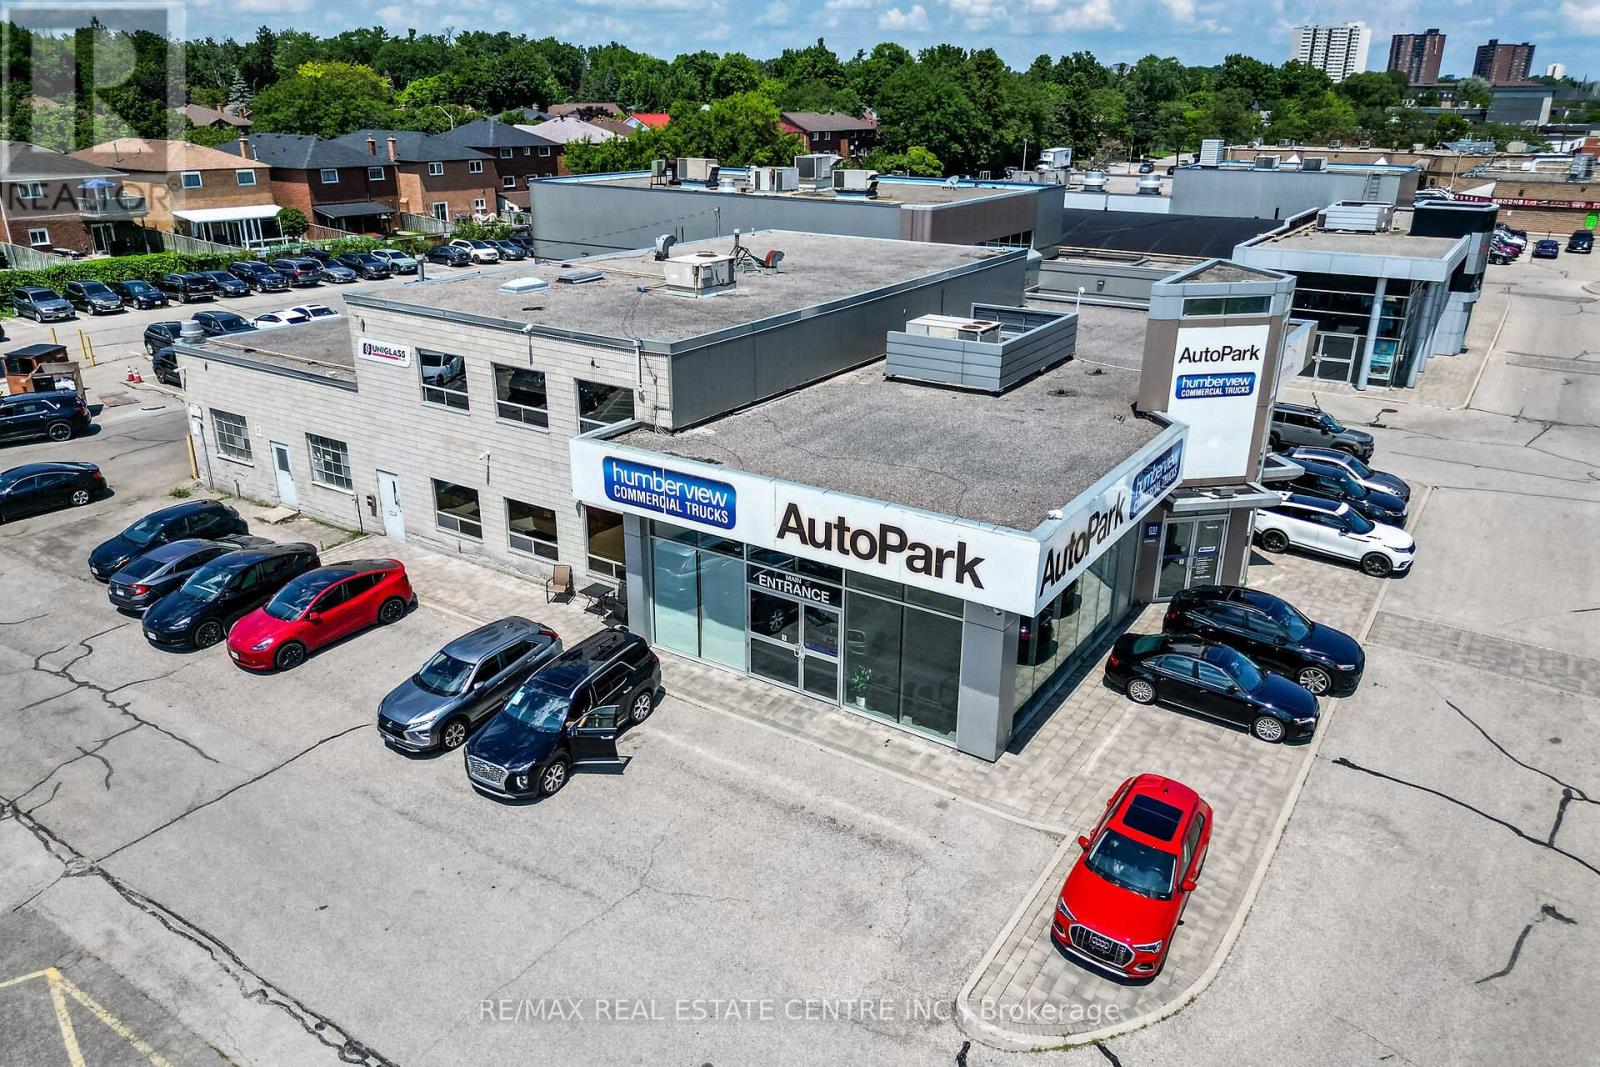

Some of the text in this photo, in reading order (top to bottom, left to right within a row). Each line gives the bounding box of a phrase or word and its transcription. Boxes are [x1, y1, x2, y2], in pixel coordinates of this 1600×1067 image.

[372, 345, 406, 358] UNIGLASS
[1178, 344, 1261, 364] AutoPark
[1181, 376, 1252, 389] humberview
[1181, 386, 1250, 398] COMMERCIAL TRUCKS
[612, 461, 728, 508] humberview
[613, 484, 729, 524] COMMERCIAL TRUCKS
[776, 501, 985, 590] AutoPark
[1038, 491, 1127, 599] AutoPark
[758, 573, 830, 604] ENTRANCE
[785, 574, 802, 584] MAIN
